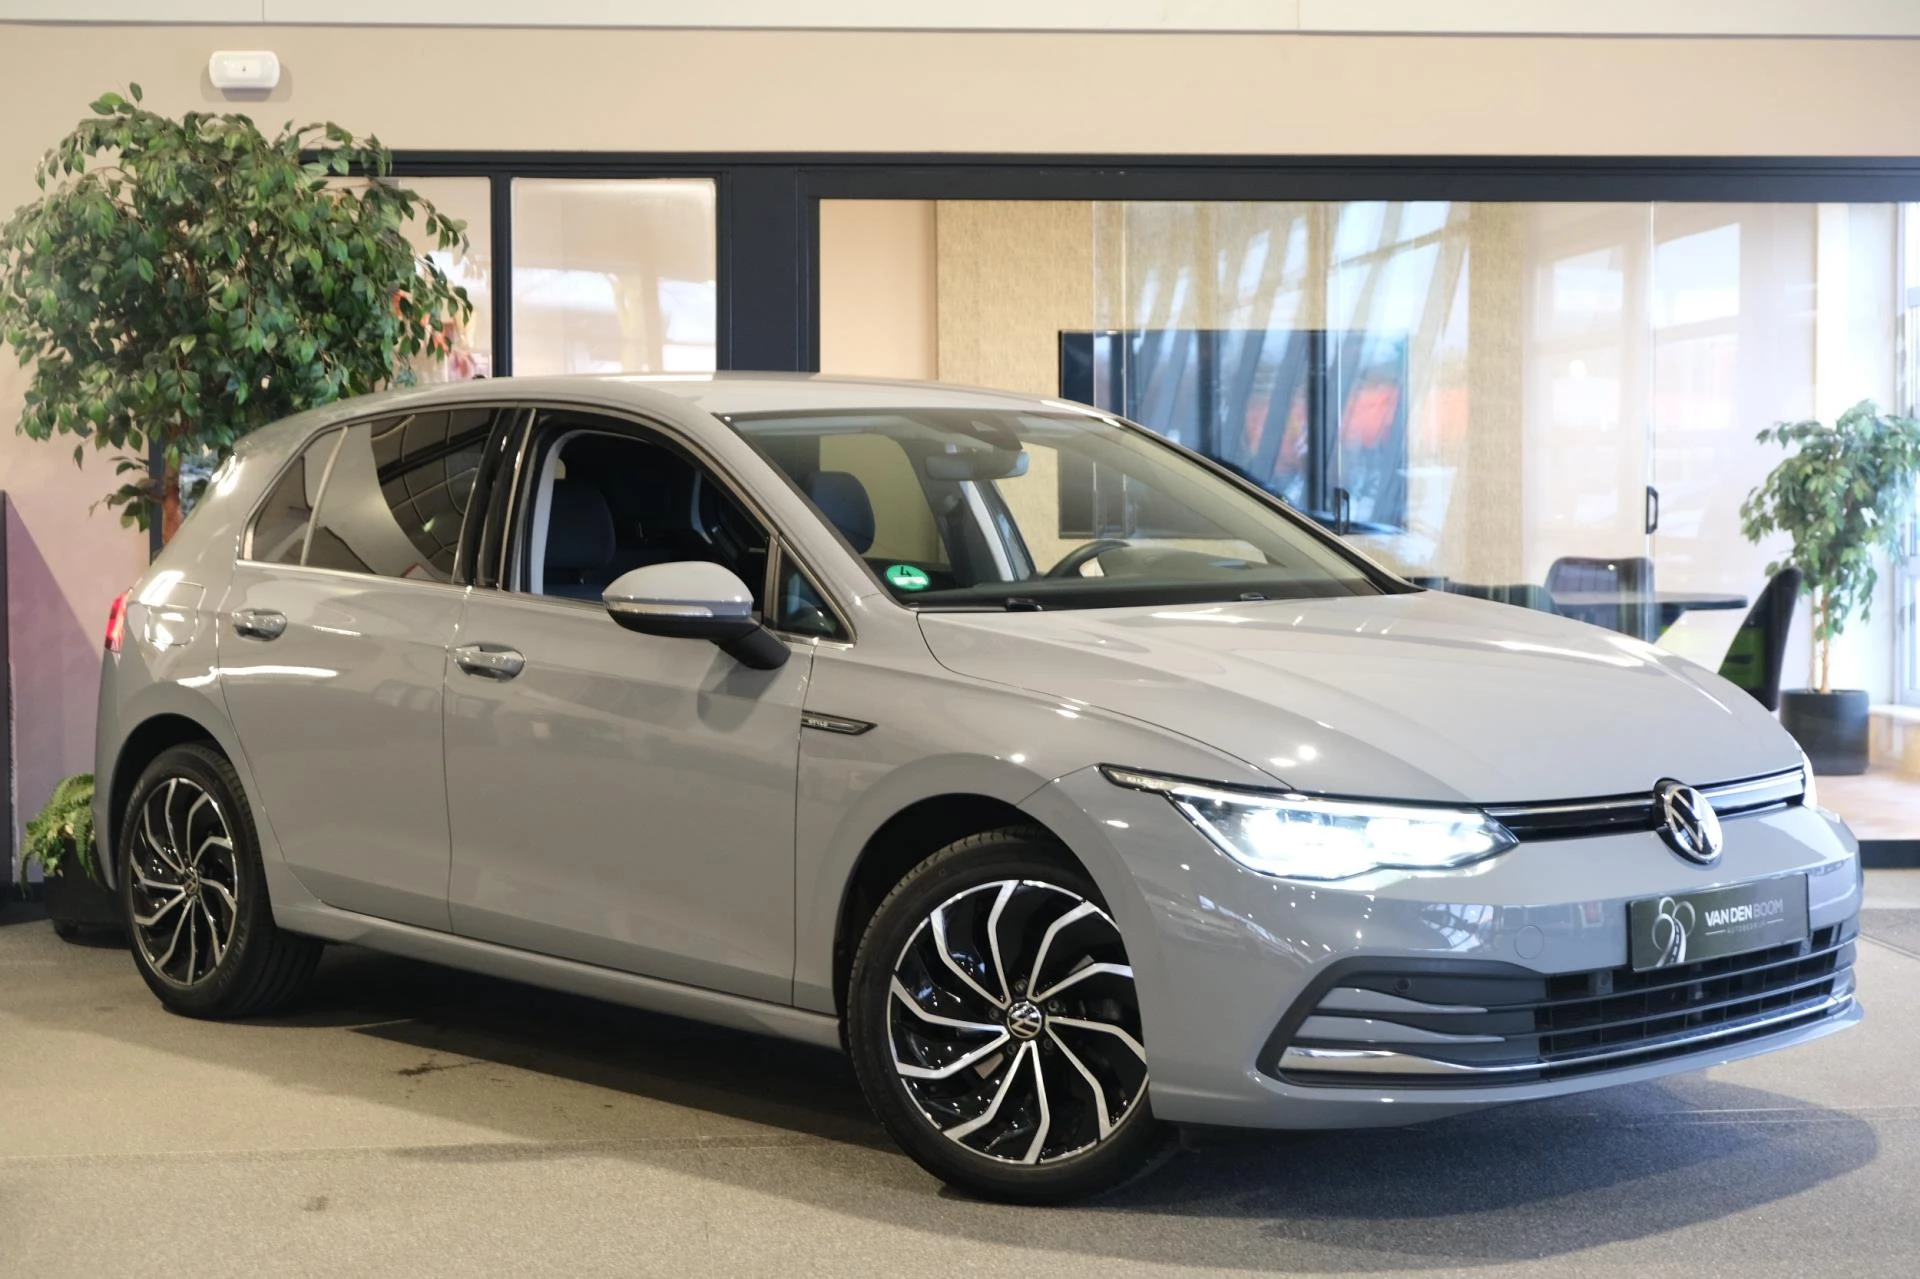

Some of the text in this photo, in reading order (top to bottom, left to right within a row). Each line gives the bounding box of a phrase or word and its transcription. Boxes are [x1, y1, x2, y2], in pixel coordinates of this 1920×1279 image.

[900, 565, 912, 577] 4
[1704, 898, 1784, 927] VAN DEN BOOM
